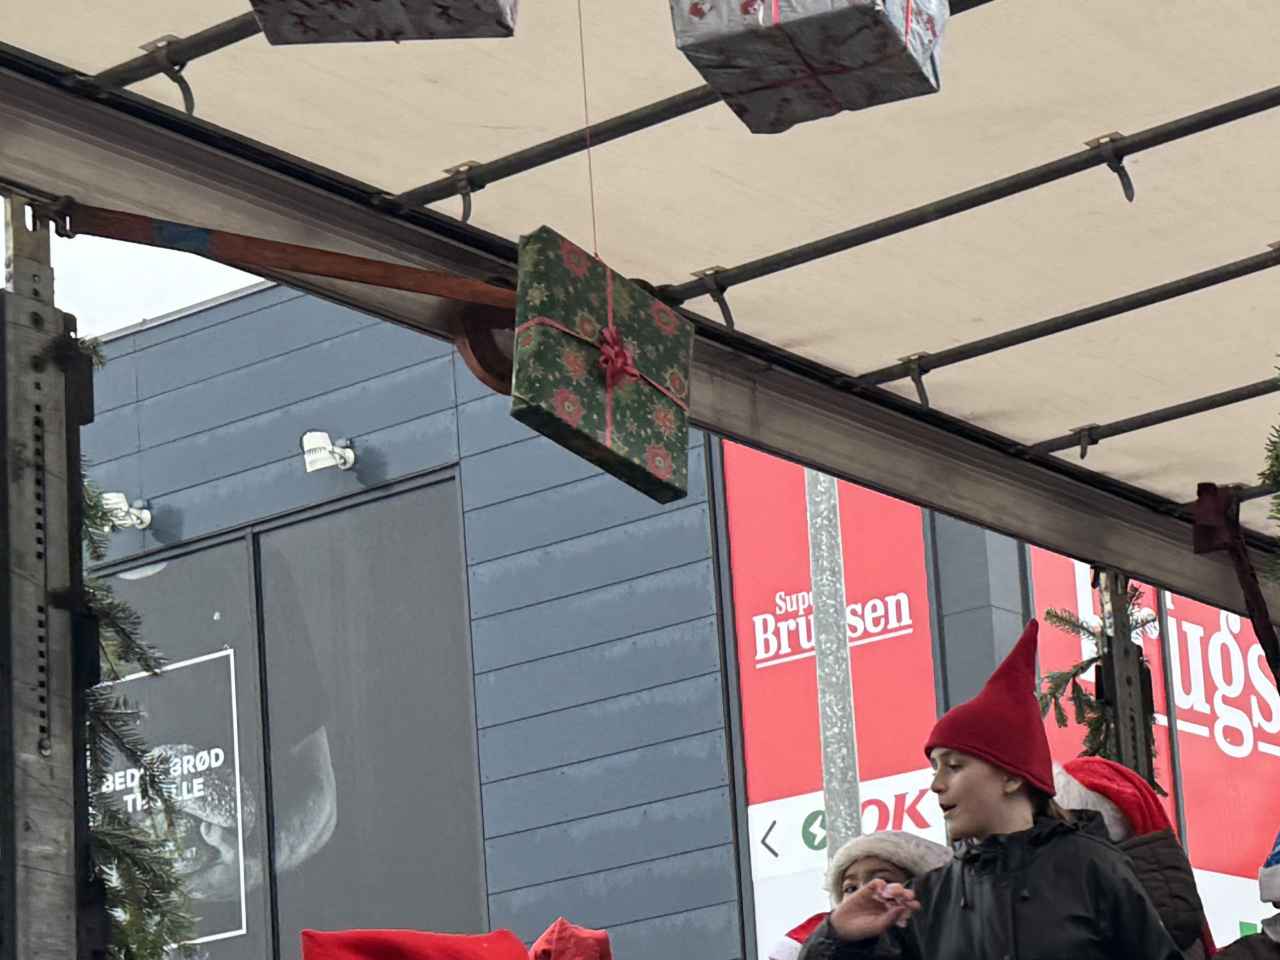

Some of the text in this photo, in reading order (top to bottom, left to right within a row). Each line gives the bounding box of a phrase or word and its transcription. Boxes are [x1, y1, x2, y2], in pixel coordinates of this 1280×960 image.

[752, 592, 913, 660] Brusen
[775, 591, 817, 616] Sup
[101, 748, 225, 793] BED BRØD
